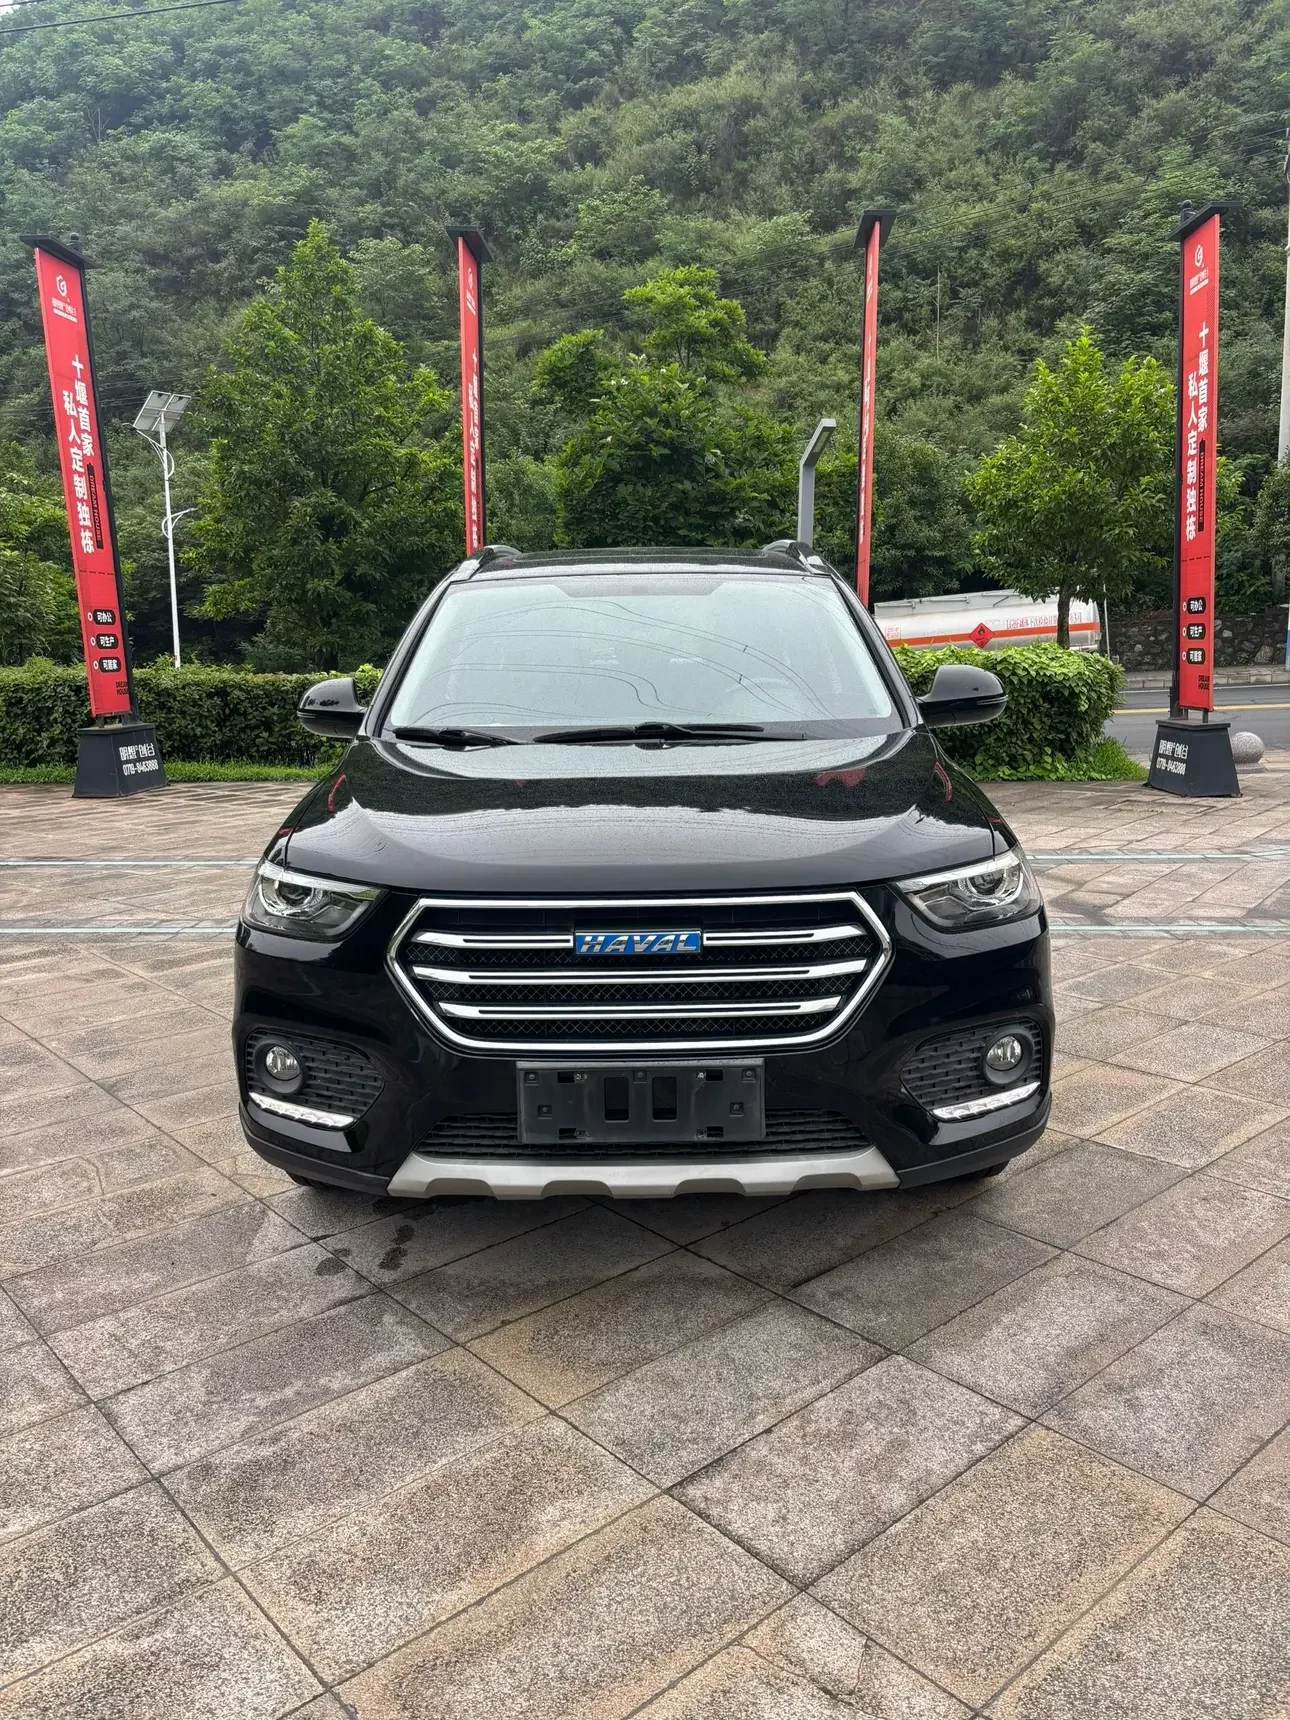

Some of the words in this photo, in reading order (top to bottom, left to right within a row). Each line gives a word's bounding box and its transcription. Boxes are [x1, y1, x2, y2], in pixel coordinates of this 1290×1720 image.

[72, 355, 94, 457] 十堰首家
[1198, 322, 1209, 433] 十堰首家
[62, 390, 94, 553] 私人定制独栋
[1186, 372, 1198, 541] 私人定制独栋
[89, 475, 97, 509] DREAM
[97, 612, 112, 623] 可办公
[100, 636, 115, 647] 可生产
[580, 934, 697, 953] HAVAL
